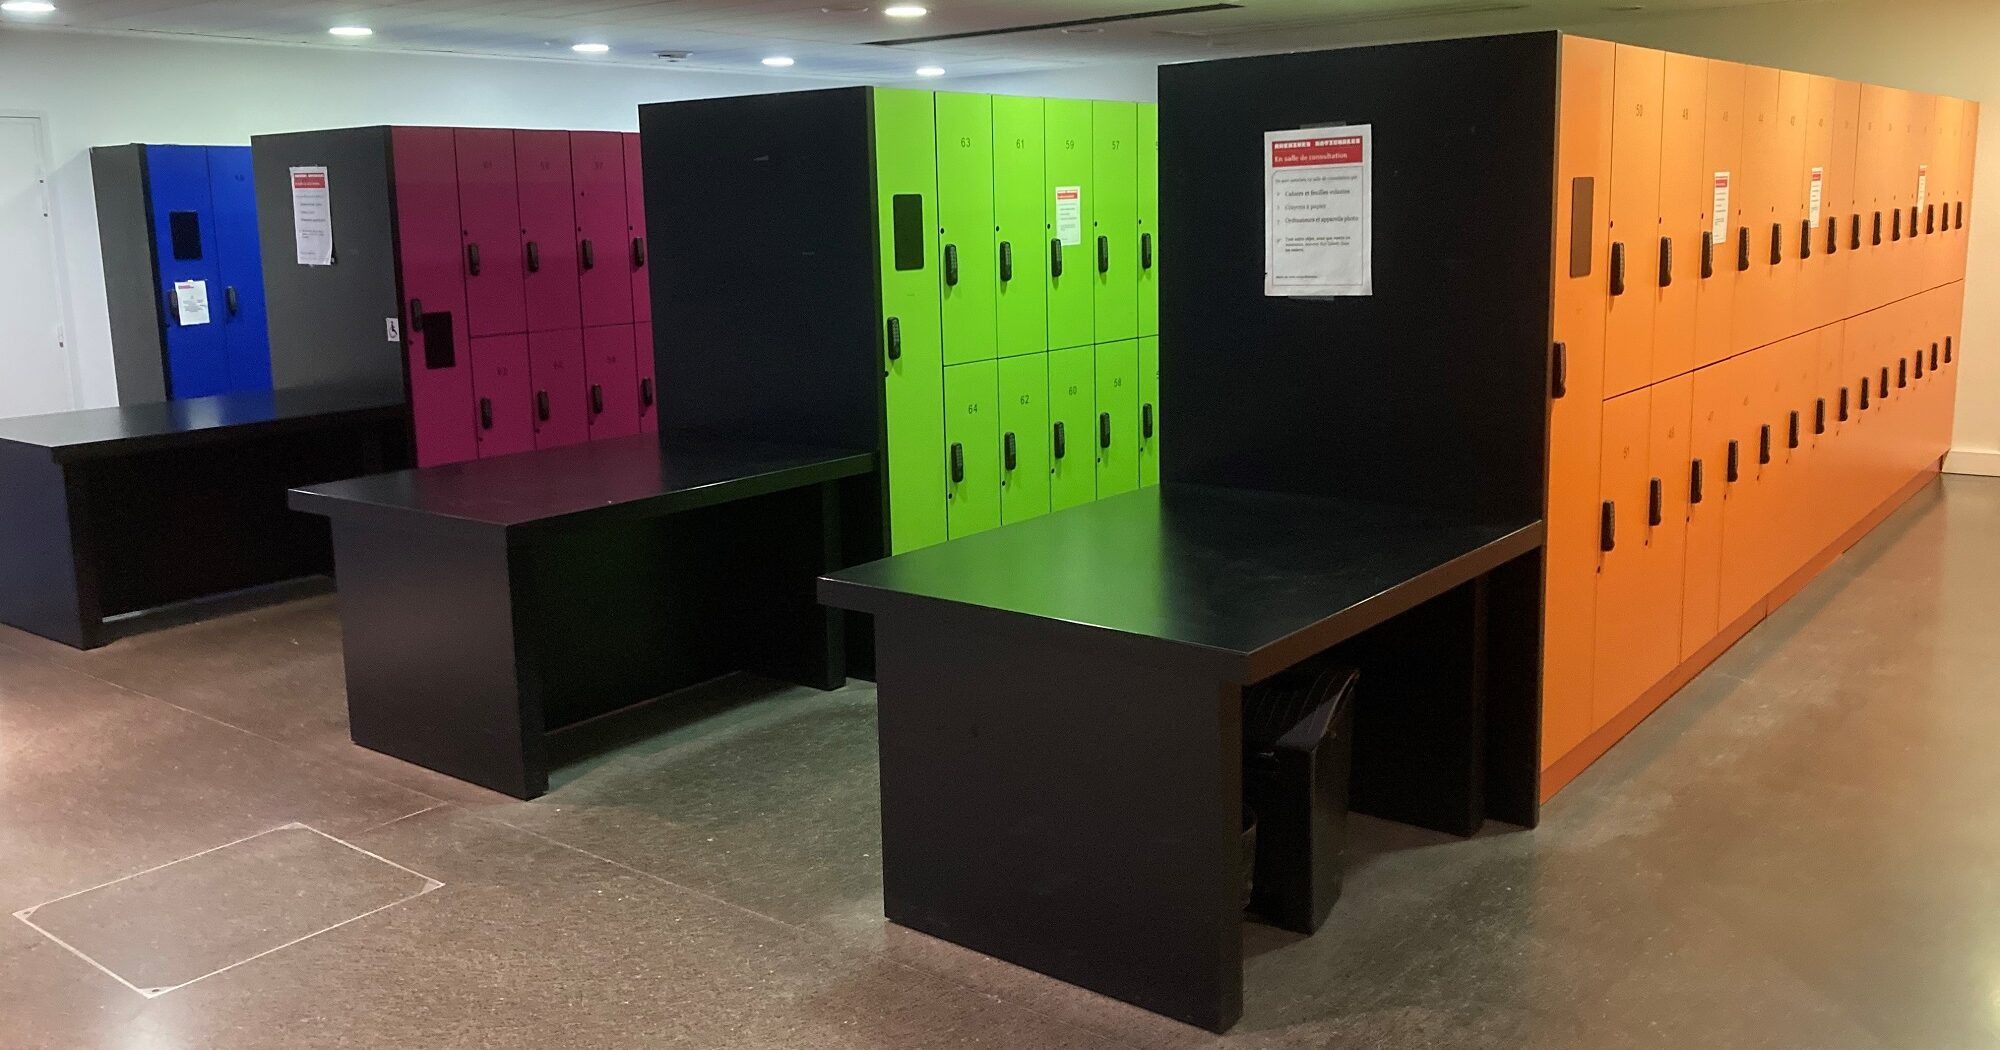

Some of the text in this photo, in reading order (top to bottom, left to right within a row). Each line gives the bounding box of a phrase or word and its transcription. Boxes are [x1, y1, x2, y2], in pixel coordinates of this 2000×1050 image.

[960, 137, 971, 148] 63
[1016, 138, 1024, 149] 61
[1065, 139, 1075, 150] 59
[1111, 140, 1120, 150] 57
[1284, 154, 1299, 162] salle
[1309, 152, 1348, 161] consultation
[1343, 215, 1358, 223] photo
[1113, 377, 1122, 388] 58
[1068, 385, 1078, 396] 60
[1020, 394, 1030, 405] 62
[968, 403, 978, 415] 64
